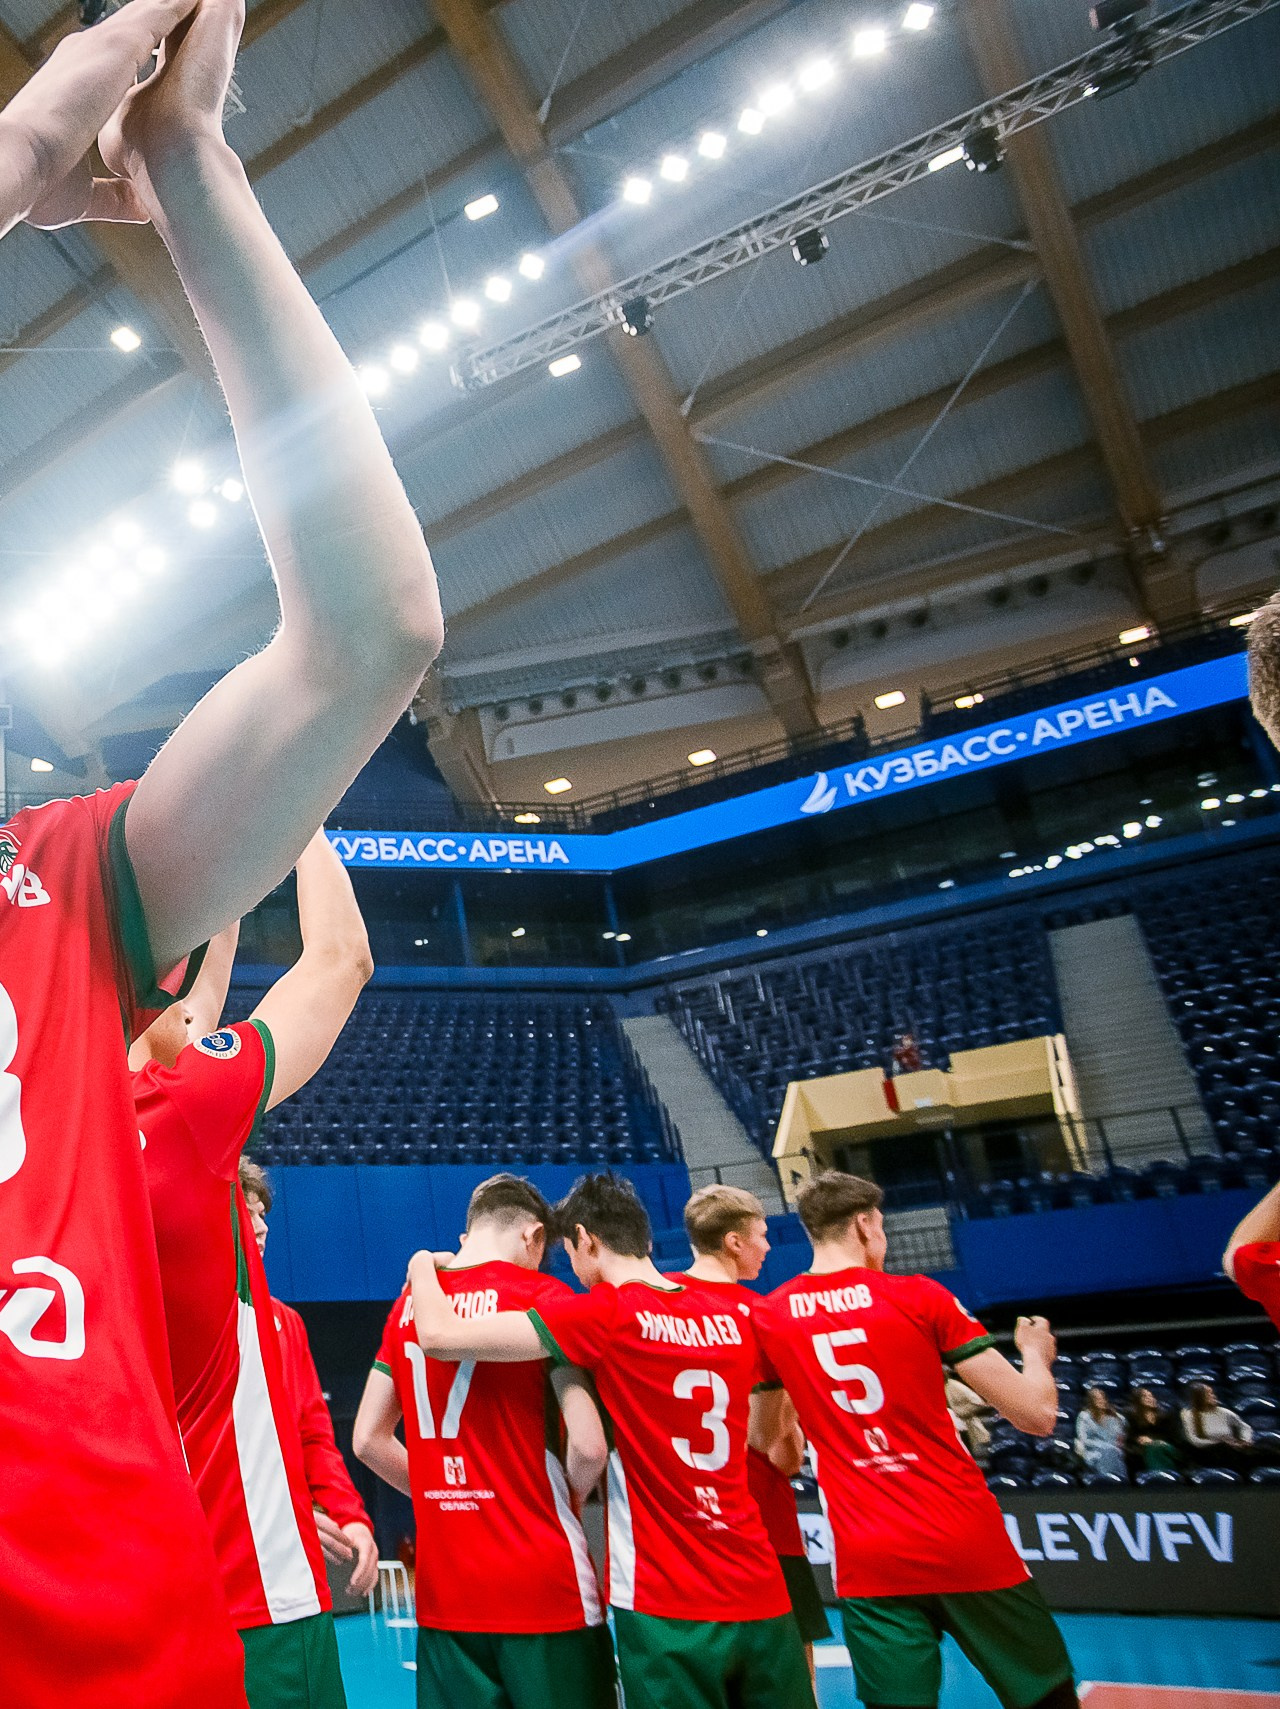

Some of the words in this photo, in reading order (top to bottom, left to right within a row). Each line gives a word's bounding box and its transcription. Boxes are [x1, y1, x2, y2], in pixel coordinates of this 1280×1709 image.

[636, 1310, 742, 1347] НИКОЛАЕВ
[789, 1284, 873, 1318] ПУЧКОВ
[404, 1341, 477, 1439] 17
[812, 1328, 885, 1415] 5
[671, 1369, 730, 1471] 3
